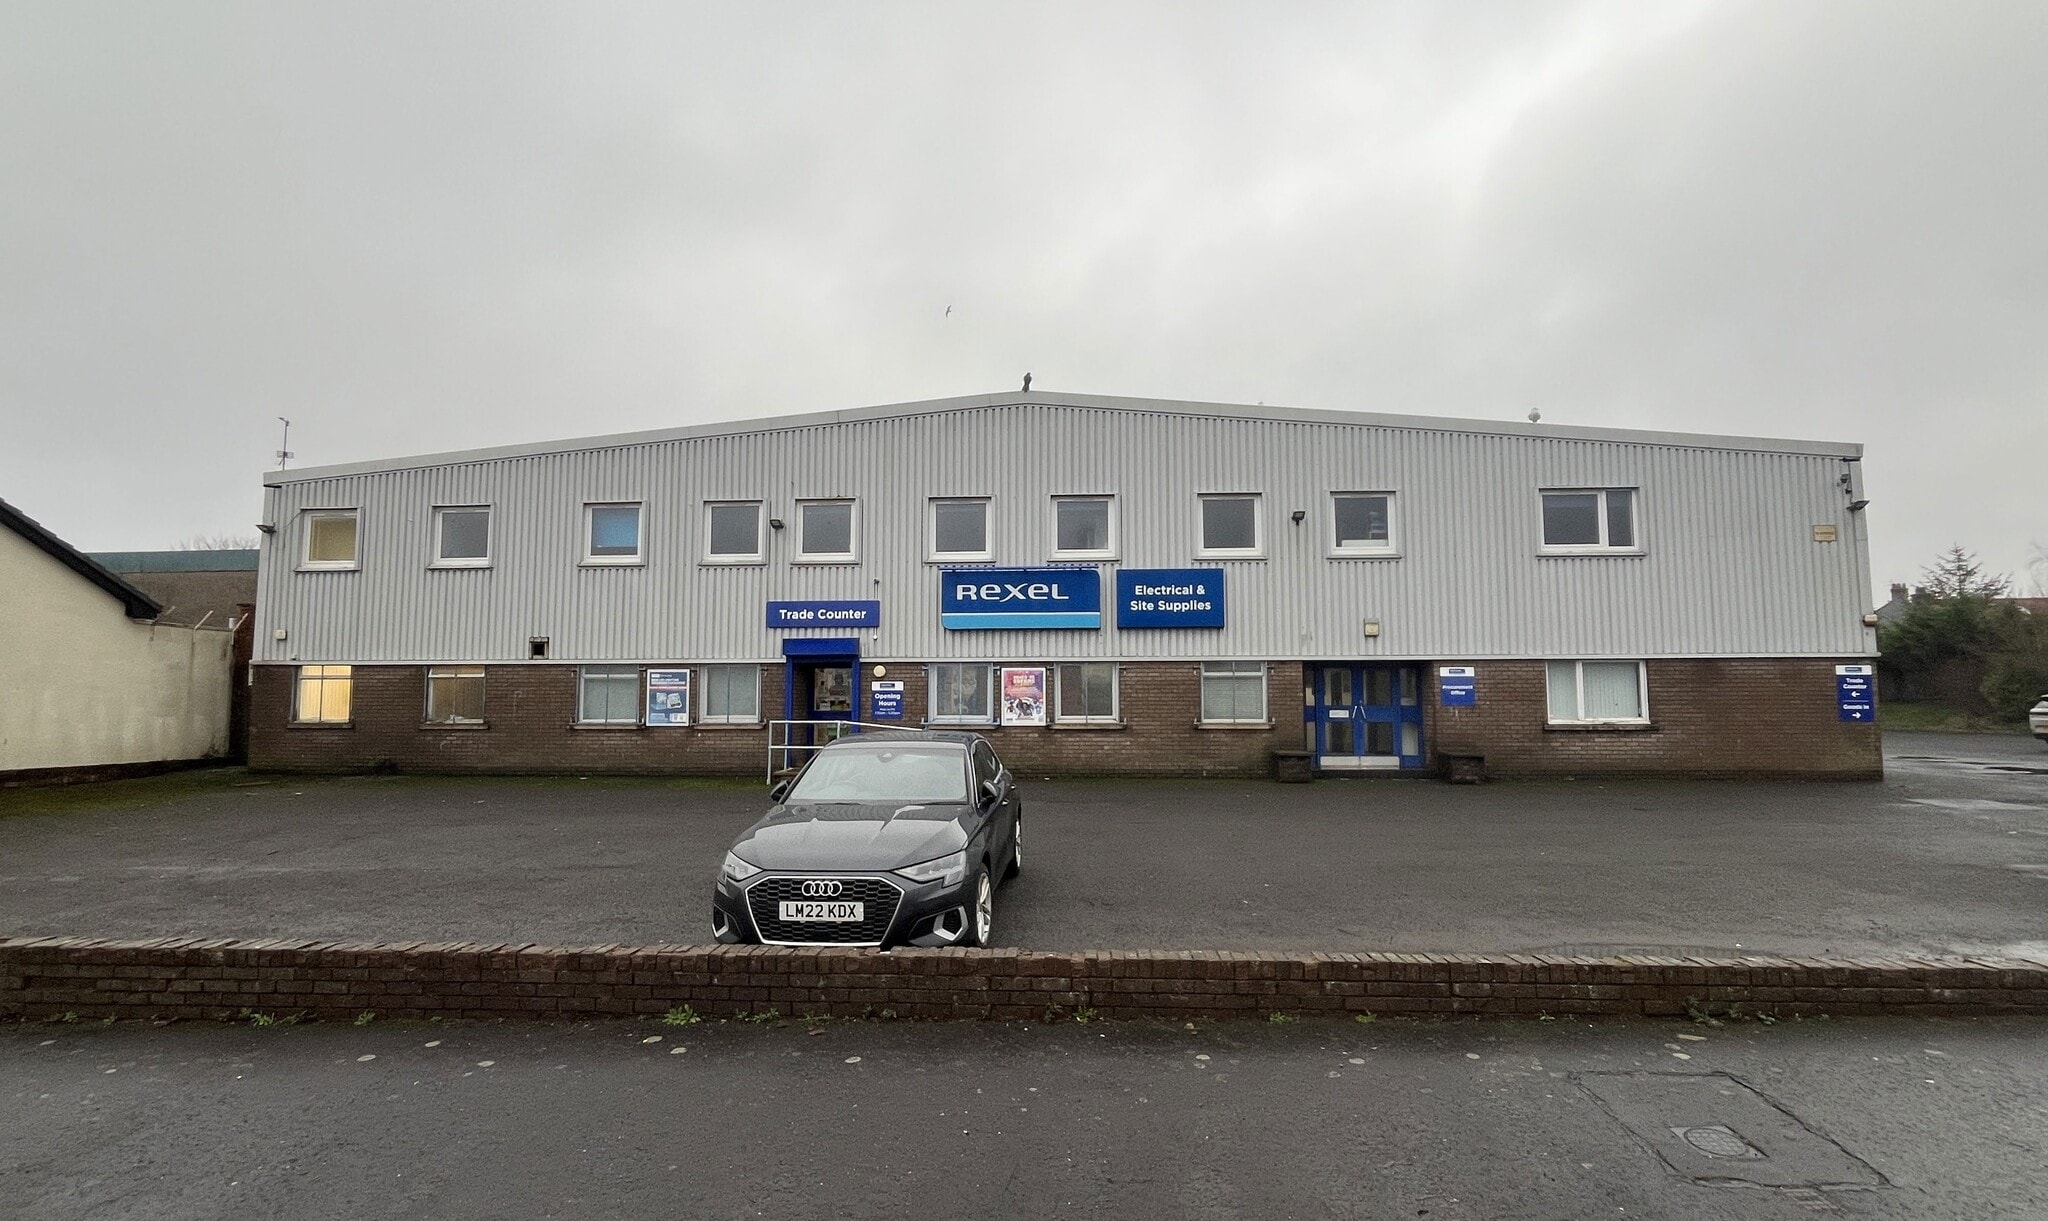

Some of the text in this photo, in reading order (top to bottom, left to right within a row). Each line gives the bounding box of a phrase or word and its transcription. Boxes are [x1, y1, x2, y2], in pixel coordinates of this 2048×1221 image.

[1135, 584, 1206, 596] Electrical &
[1130, 600, 1212, 613] Site Supplies
[779, 609, 867, 620] Trade Counter
[786, 904, 857, 918] LM22 KDX
